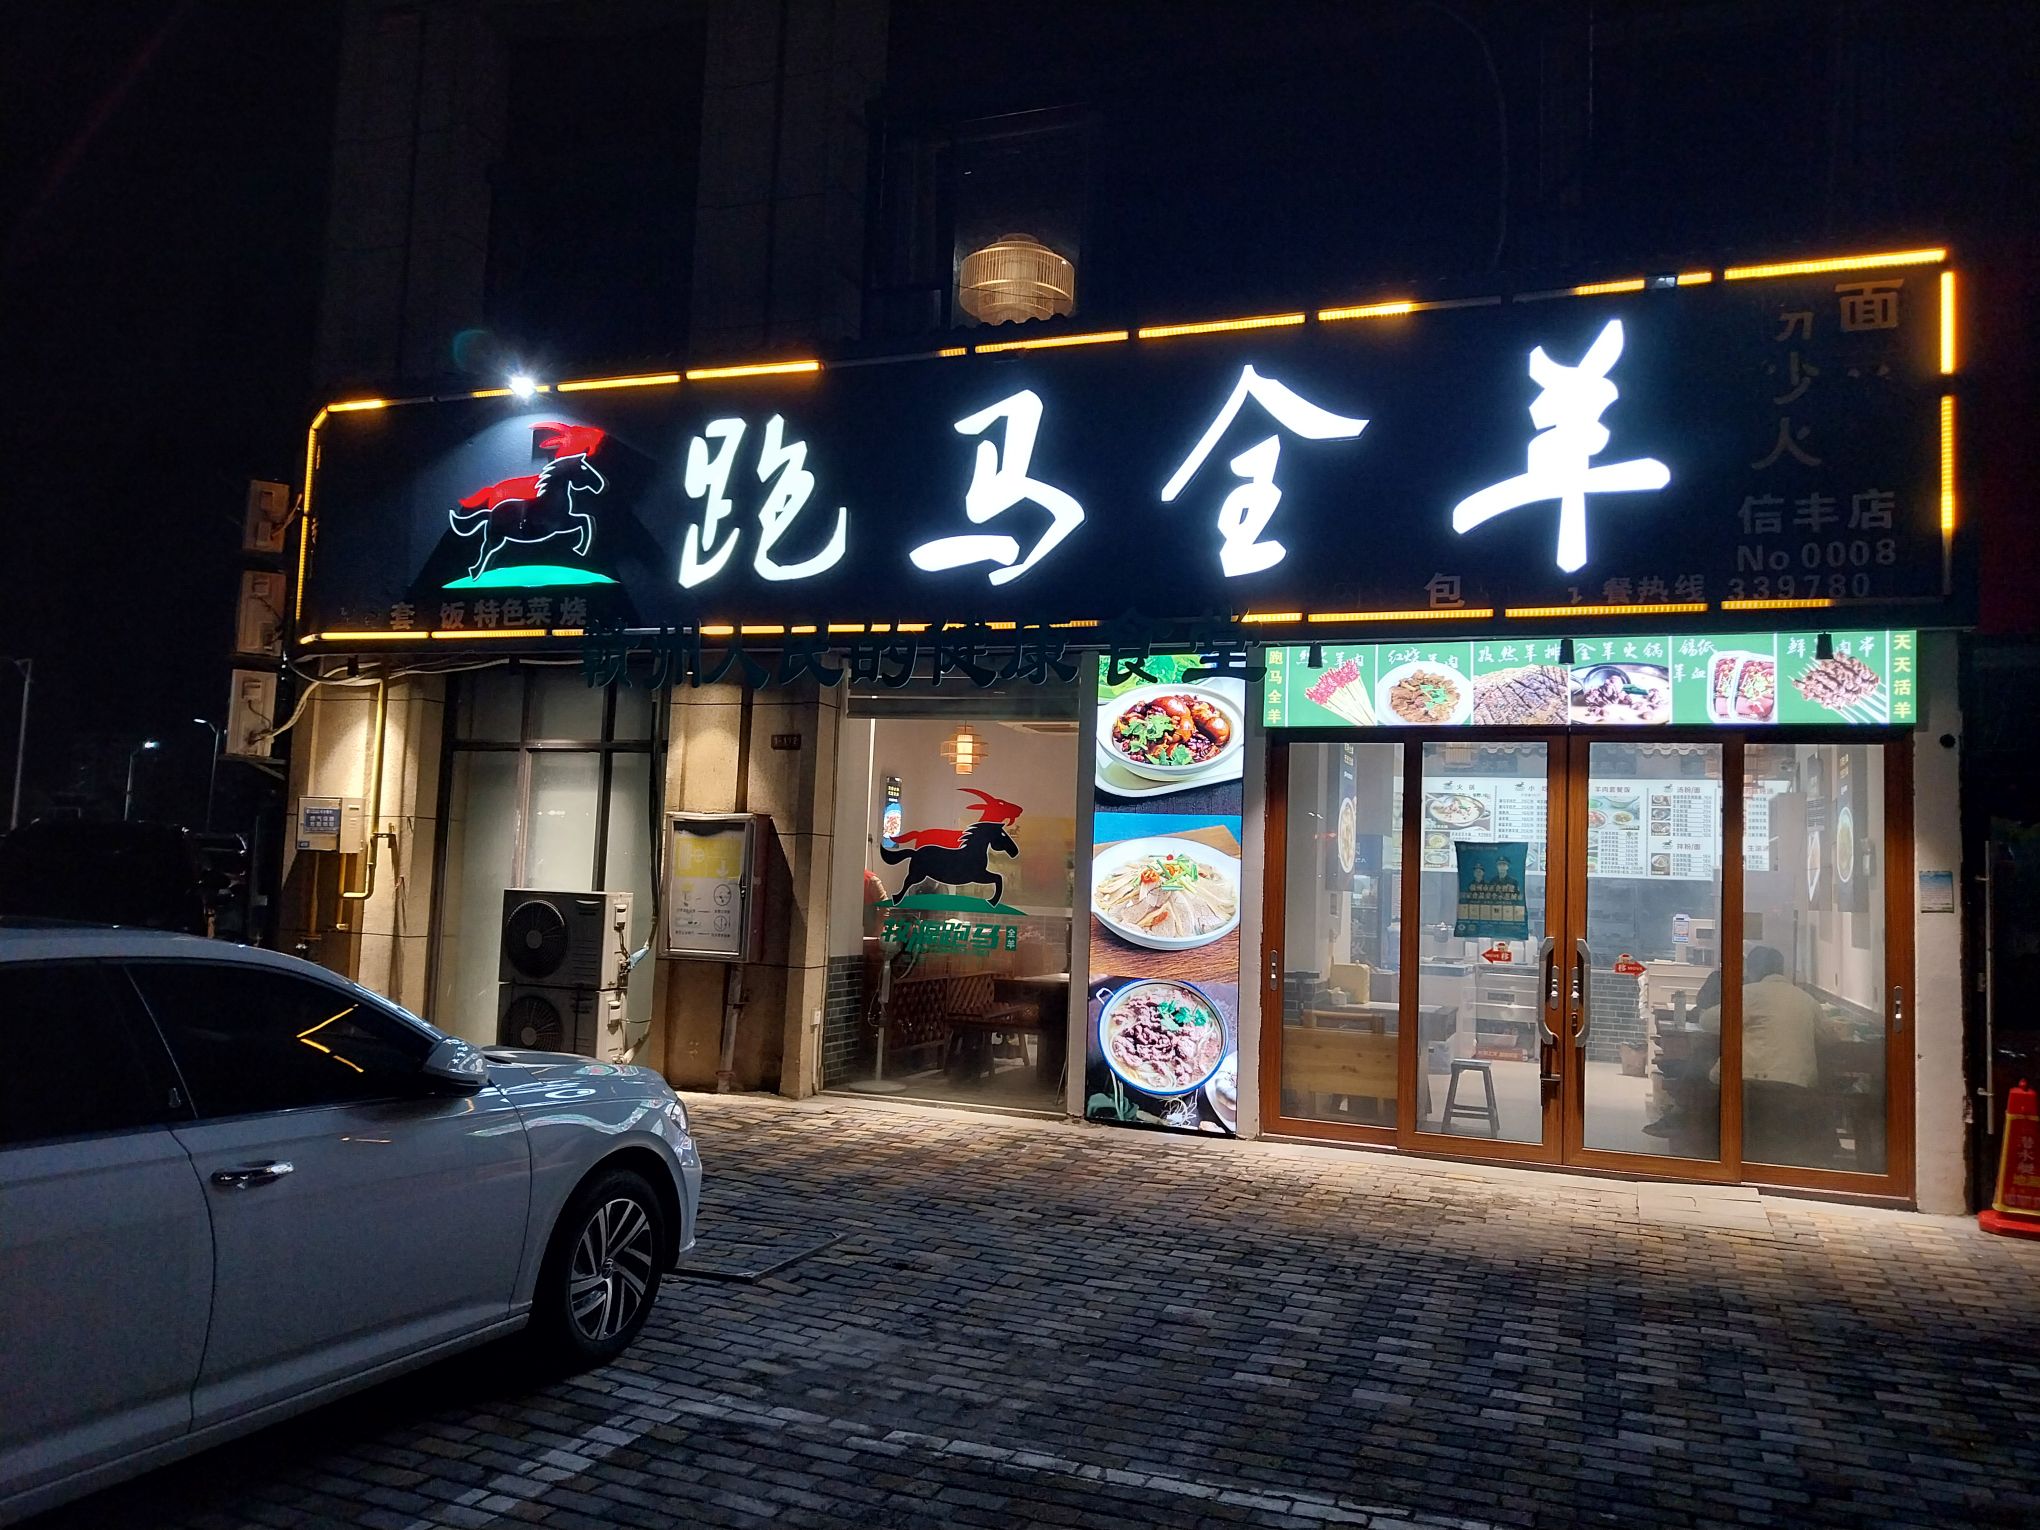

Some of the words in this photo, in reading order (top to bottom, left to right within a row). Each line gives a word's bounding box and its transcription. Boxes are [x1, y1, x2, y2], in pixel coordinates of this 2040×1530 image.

[678, 318, 1671, 590] 跑马全羊
[1738, 488, 1897, 536] 信丰店
[1802, 539, 1897, 569] 0008
[1575, 641, 1663, 661] 全羊火锅
[1787, 635, 1874, 658] 鲜肉串
[1268, 651, 1284, 725] 跑马全羊
[1893, 633, 1911, 719] 天天活羊
